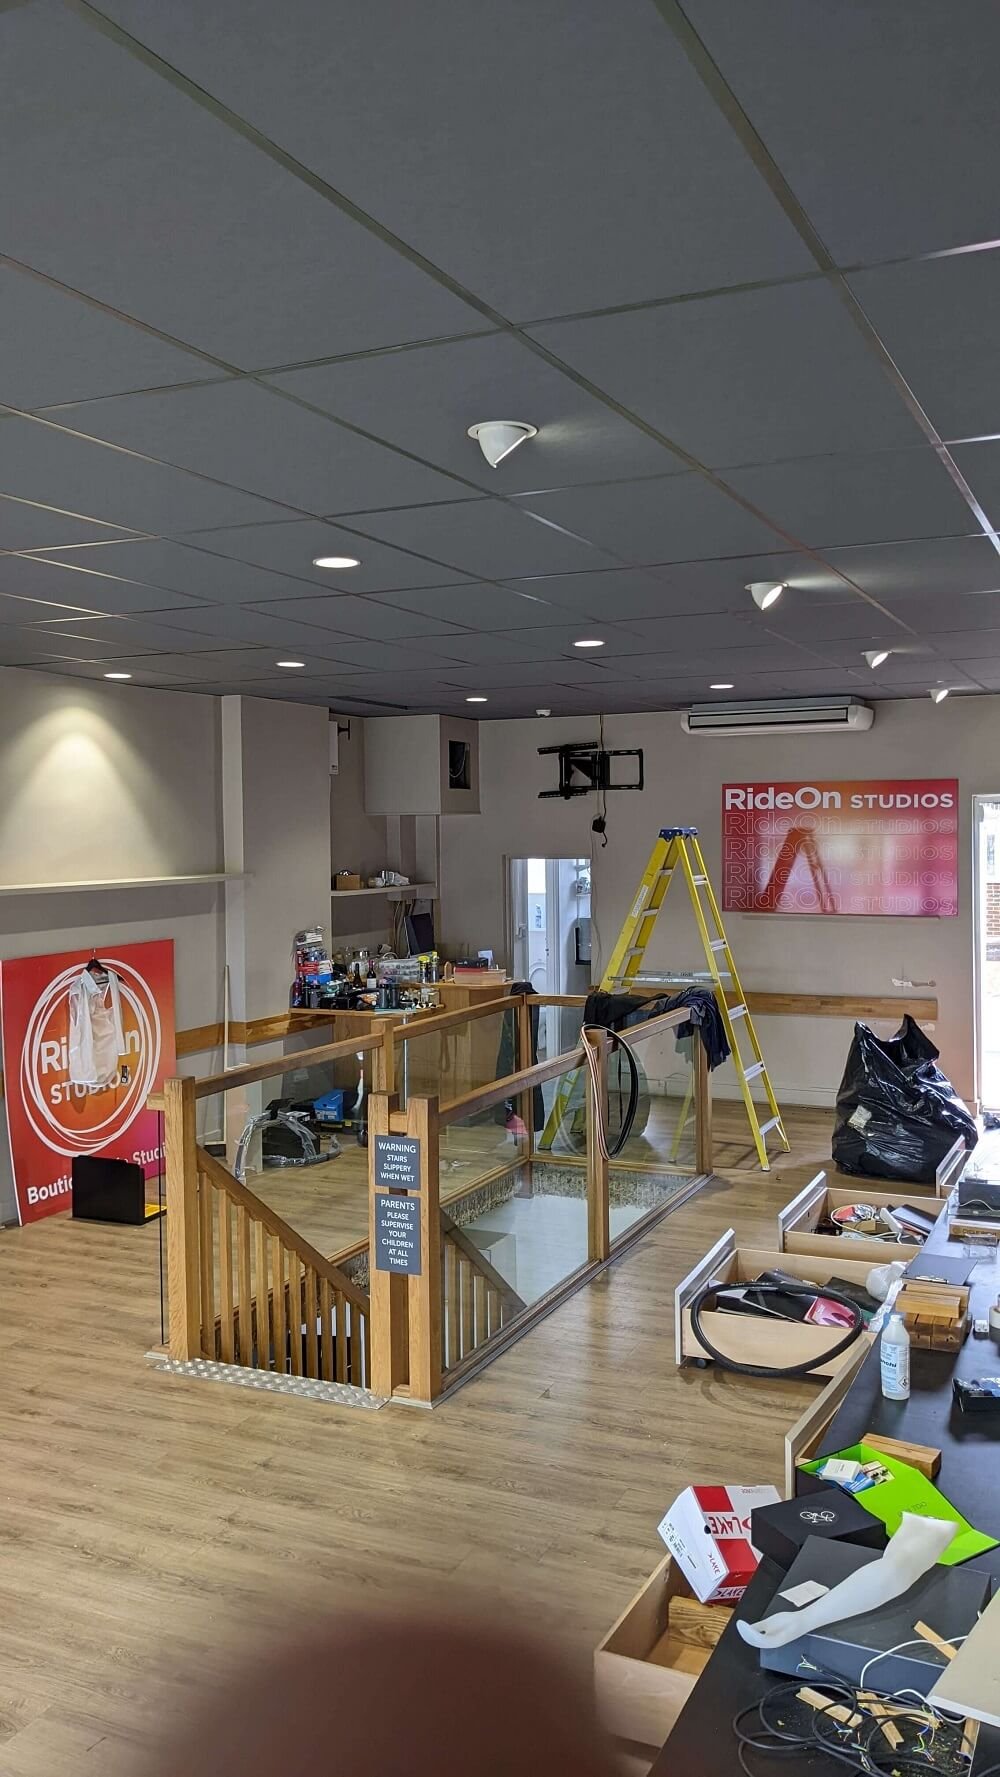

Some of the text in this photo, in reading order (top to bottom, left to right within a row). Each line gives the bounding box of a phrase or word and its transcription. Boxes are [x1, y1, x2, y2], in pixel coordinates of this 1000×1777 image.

[725, 786, 954, 811] RideOn STUDIOS
[724, 811, 842, 835] RideOn
[725, 836, 842, 861] RideOn
[725, 861, 842, 885] RideOn
[724, 885, 842, 910] RideOn
[40, 1029, 140, 1075] Rin
[378, 1141, 417, 1154] WARNING
[386, 1154, 408, 1163] STAIRS
[383, 1163, 411, 1172] SLIPPERY
[380, 1171, 416, 1182] WHEN WET
[380, 1199, 415, 1211] PARENTS
[386, 1211, 409, 1220] PLEASE
[381, 1220, 414, 1230] SUPERVISE
[388, 1229, 407, 1239] YOUR
[381, 1238, 414, 1249] CHILDREN
[388, 1248, 409, 1258] AT ALL
[389, 1257, 408, 1267] TIMES
[708, 1516, 742, 1534] LAKE
